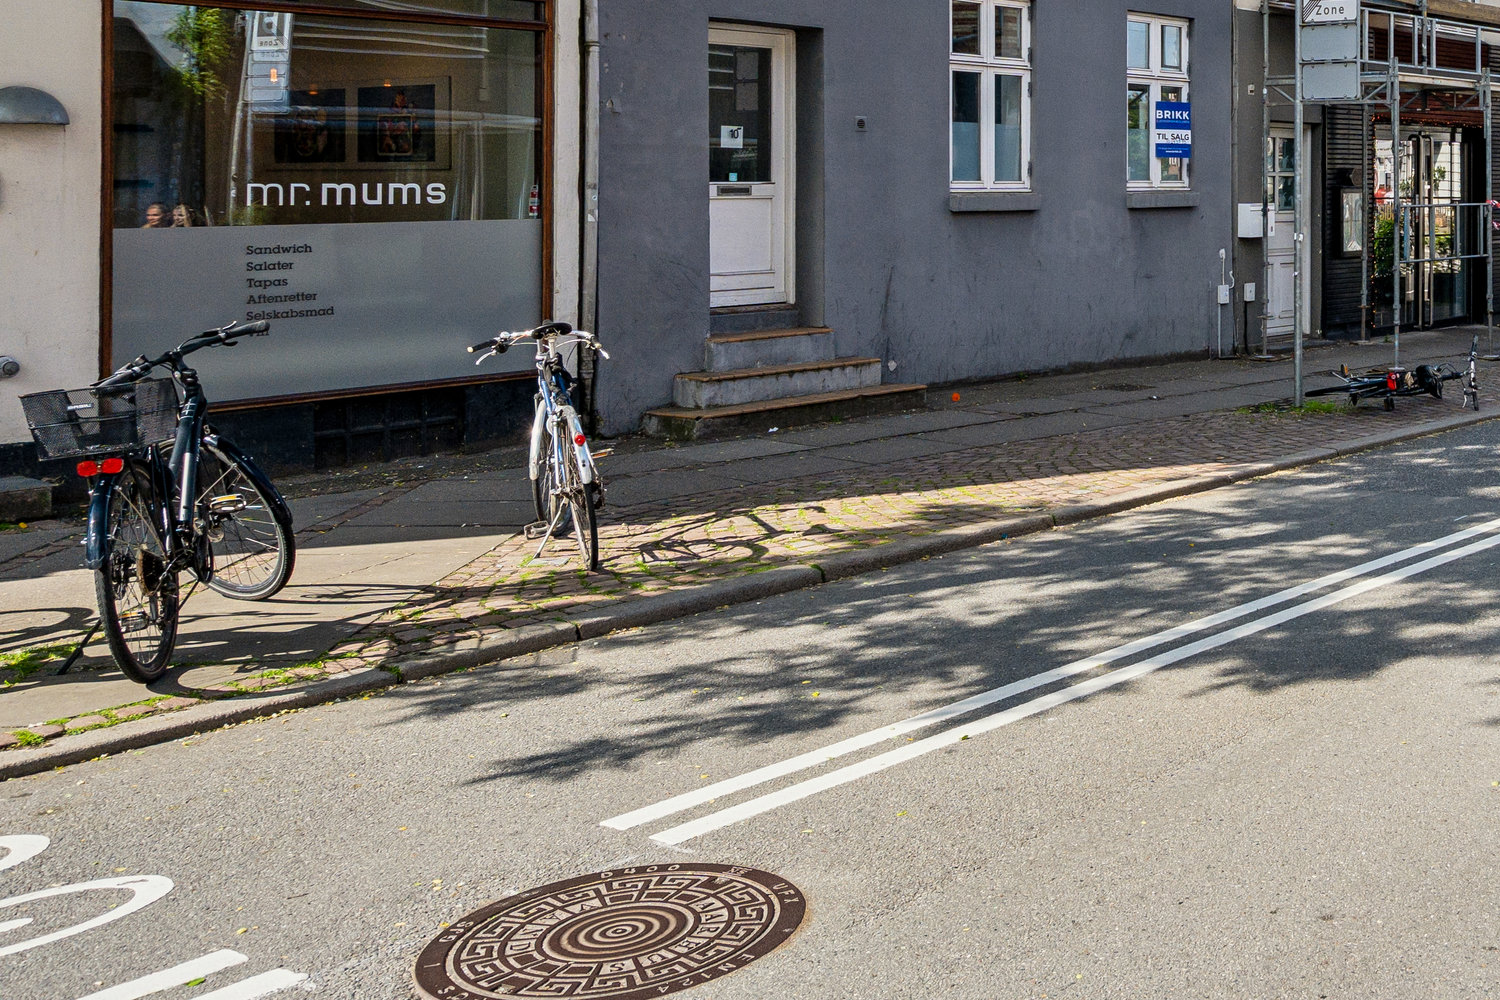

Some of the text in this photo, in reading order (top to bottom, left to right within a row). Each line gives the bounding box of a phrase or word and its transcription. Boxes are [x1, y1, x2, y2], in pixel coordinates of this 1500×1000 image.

[1316, 5, 1345, 15] Zone
[1156, 110, 1190, 120] BRIKK
[1171, 133, 1190, 141] SALG
[246, 182, 447, 206] mr. mums
[246, 243, 313, 256] Sandwich
[246, 261, 294, 272] Salater
[246, 277, 288, 290] Tapas
[246, 292, 318, 305] Aftenretter
[246, 306, 335, 321] Selskabsmad
[609, 899, 725, 973] AARHUS
